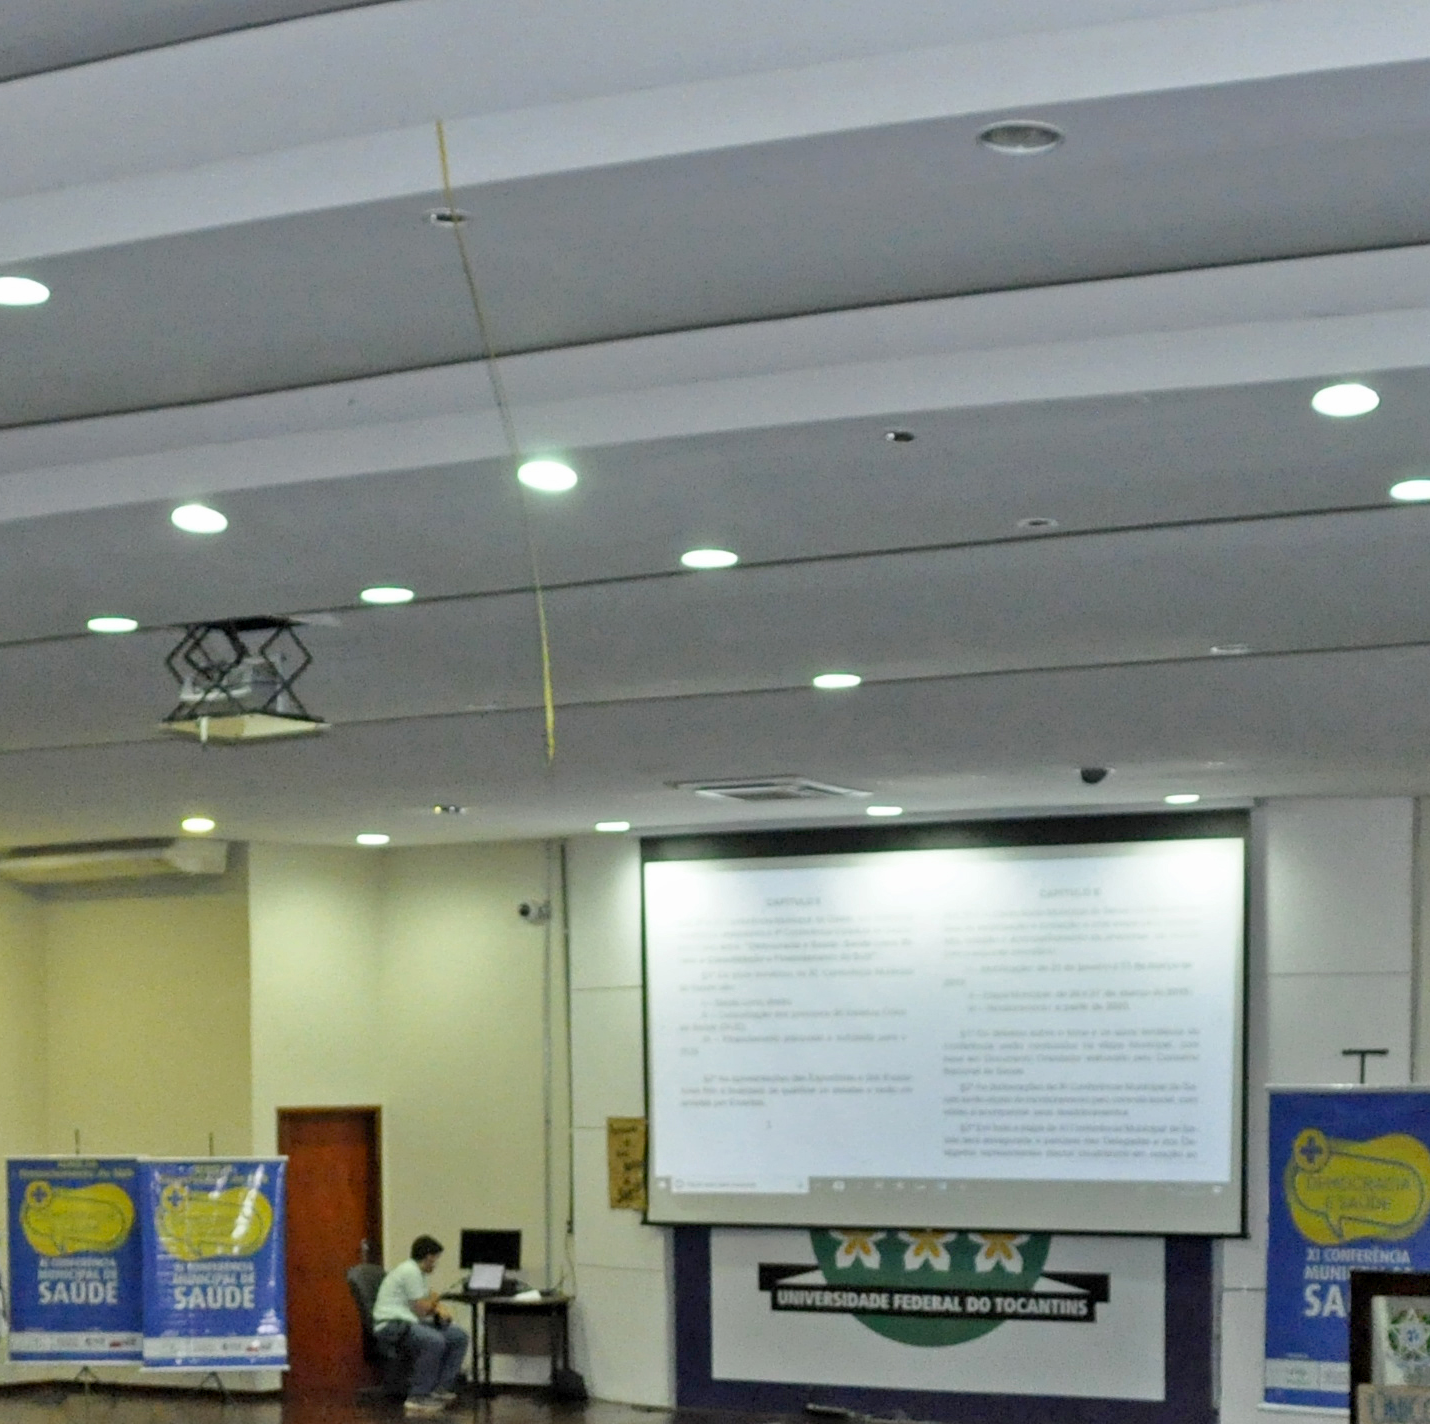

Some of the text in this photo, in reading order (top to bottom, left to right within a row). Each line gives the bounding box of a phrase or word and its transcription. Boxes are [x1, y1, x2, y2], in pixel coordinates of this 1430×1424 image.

[1323, 1246, 1411, 1264] CONFERÊNCIA
[38, 1279, 118, 1305] SAÚDE
[174, 1284, 255, 1310] SAÚDE
[776, 1289, 1089, 1317] UNIVERSIDADE FEDERAL DO TOCANTINS
